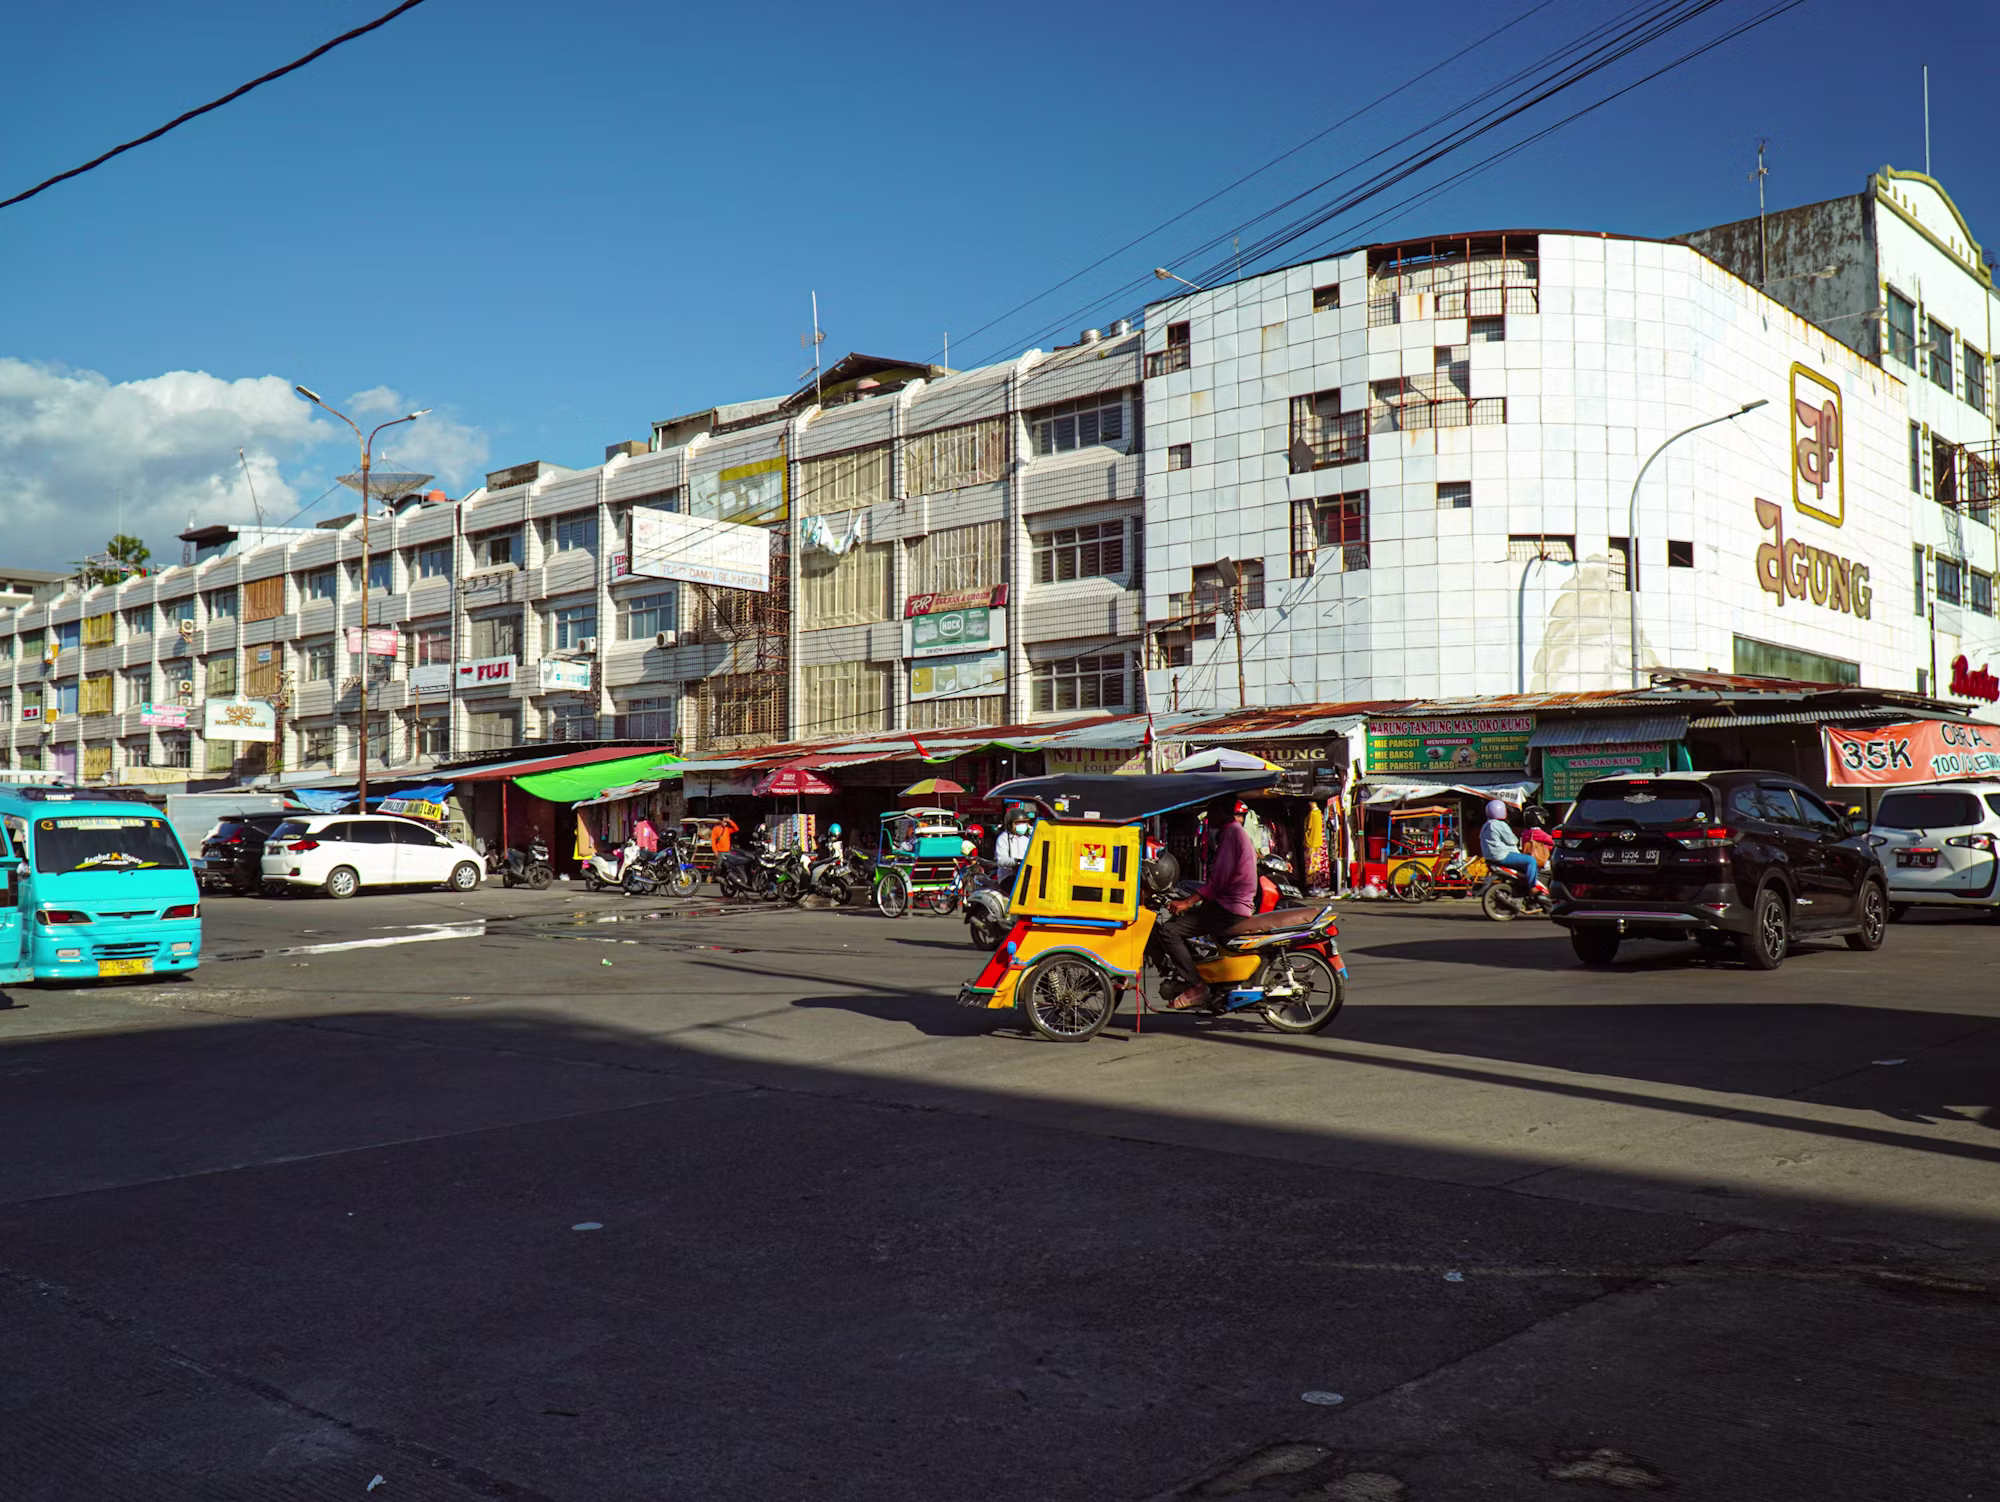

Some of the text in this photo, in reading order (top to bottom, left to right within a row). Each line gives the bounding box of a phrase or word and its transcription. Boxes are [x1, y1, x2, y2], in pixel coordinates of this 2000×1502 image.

[941, 619, 961, 631] HOCK
[477, 661, 510, 681] FUJI
[214, 719, 241, 727] MARTHA
[1369, 717, 1531, 736] WARUNG TANJUNG MAS JOKO KUMIS
[1374, 739, 1420, 748] MIE PANGSIT
[1549, 742, 1663, 756] WARUNG TANJUNG
[1374, 750, 1414, 759] MIE BAKSO
[1842, 738, 1913, 770] 35K
[1085, 764, 1145, 772] COLLECTION
[1374, 762, 1388, 770] MIE
[1389, 762, 1420, 770] PANGSIT
[1429, 761, 1455, 769] BAKSO
[1569, 757, 1641, 768] MAS JOKO KUMIS
